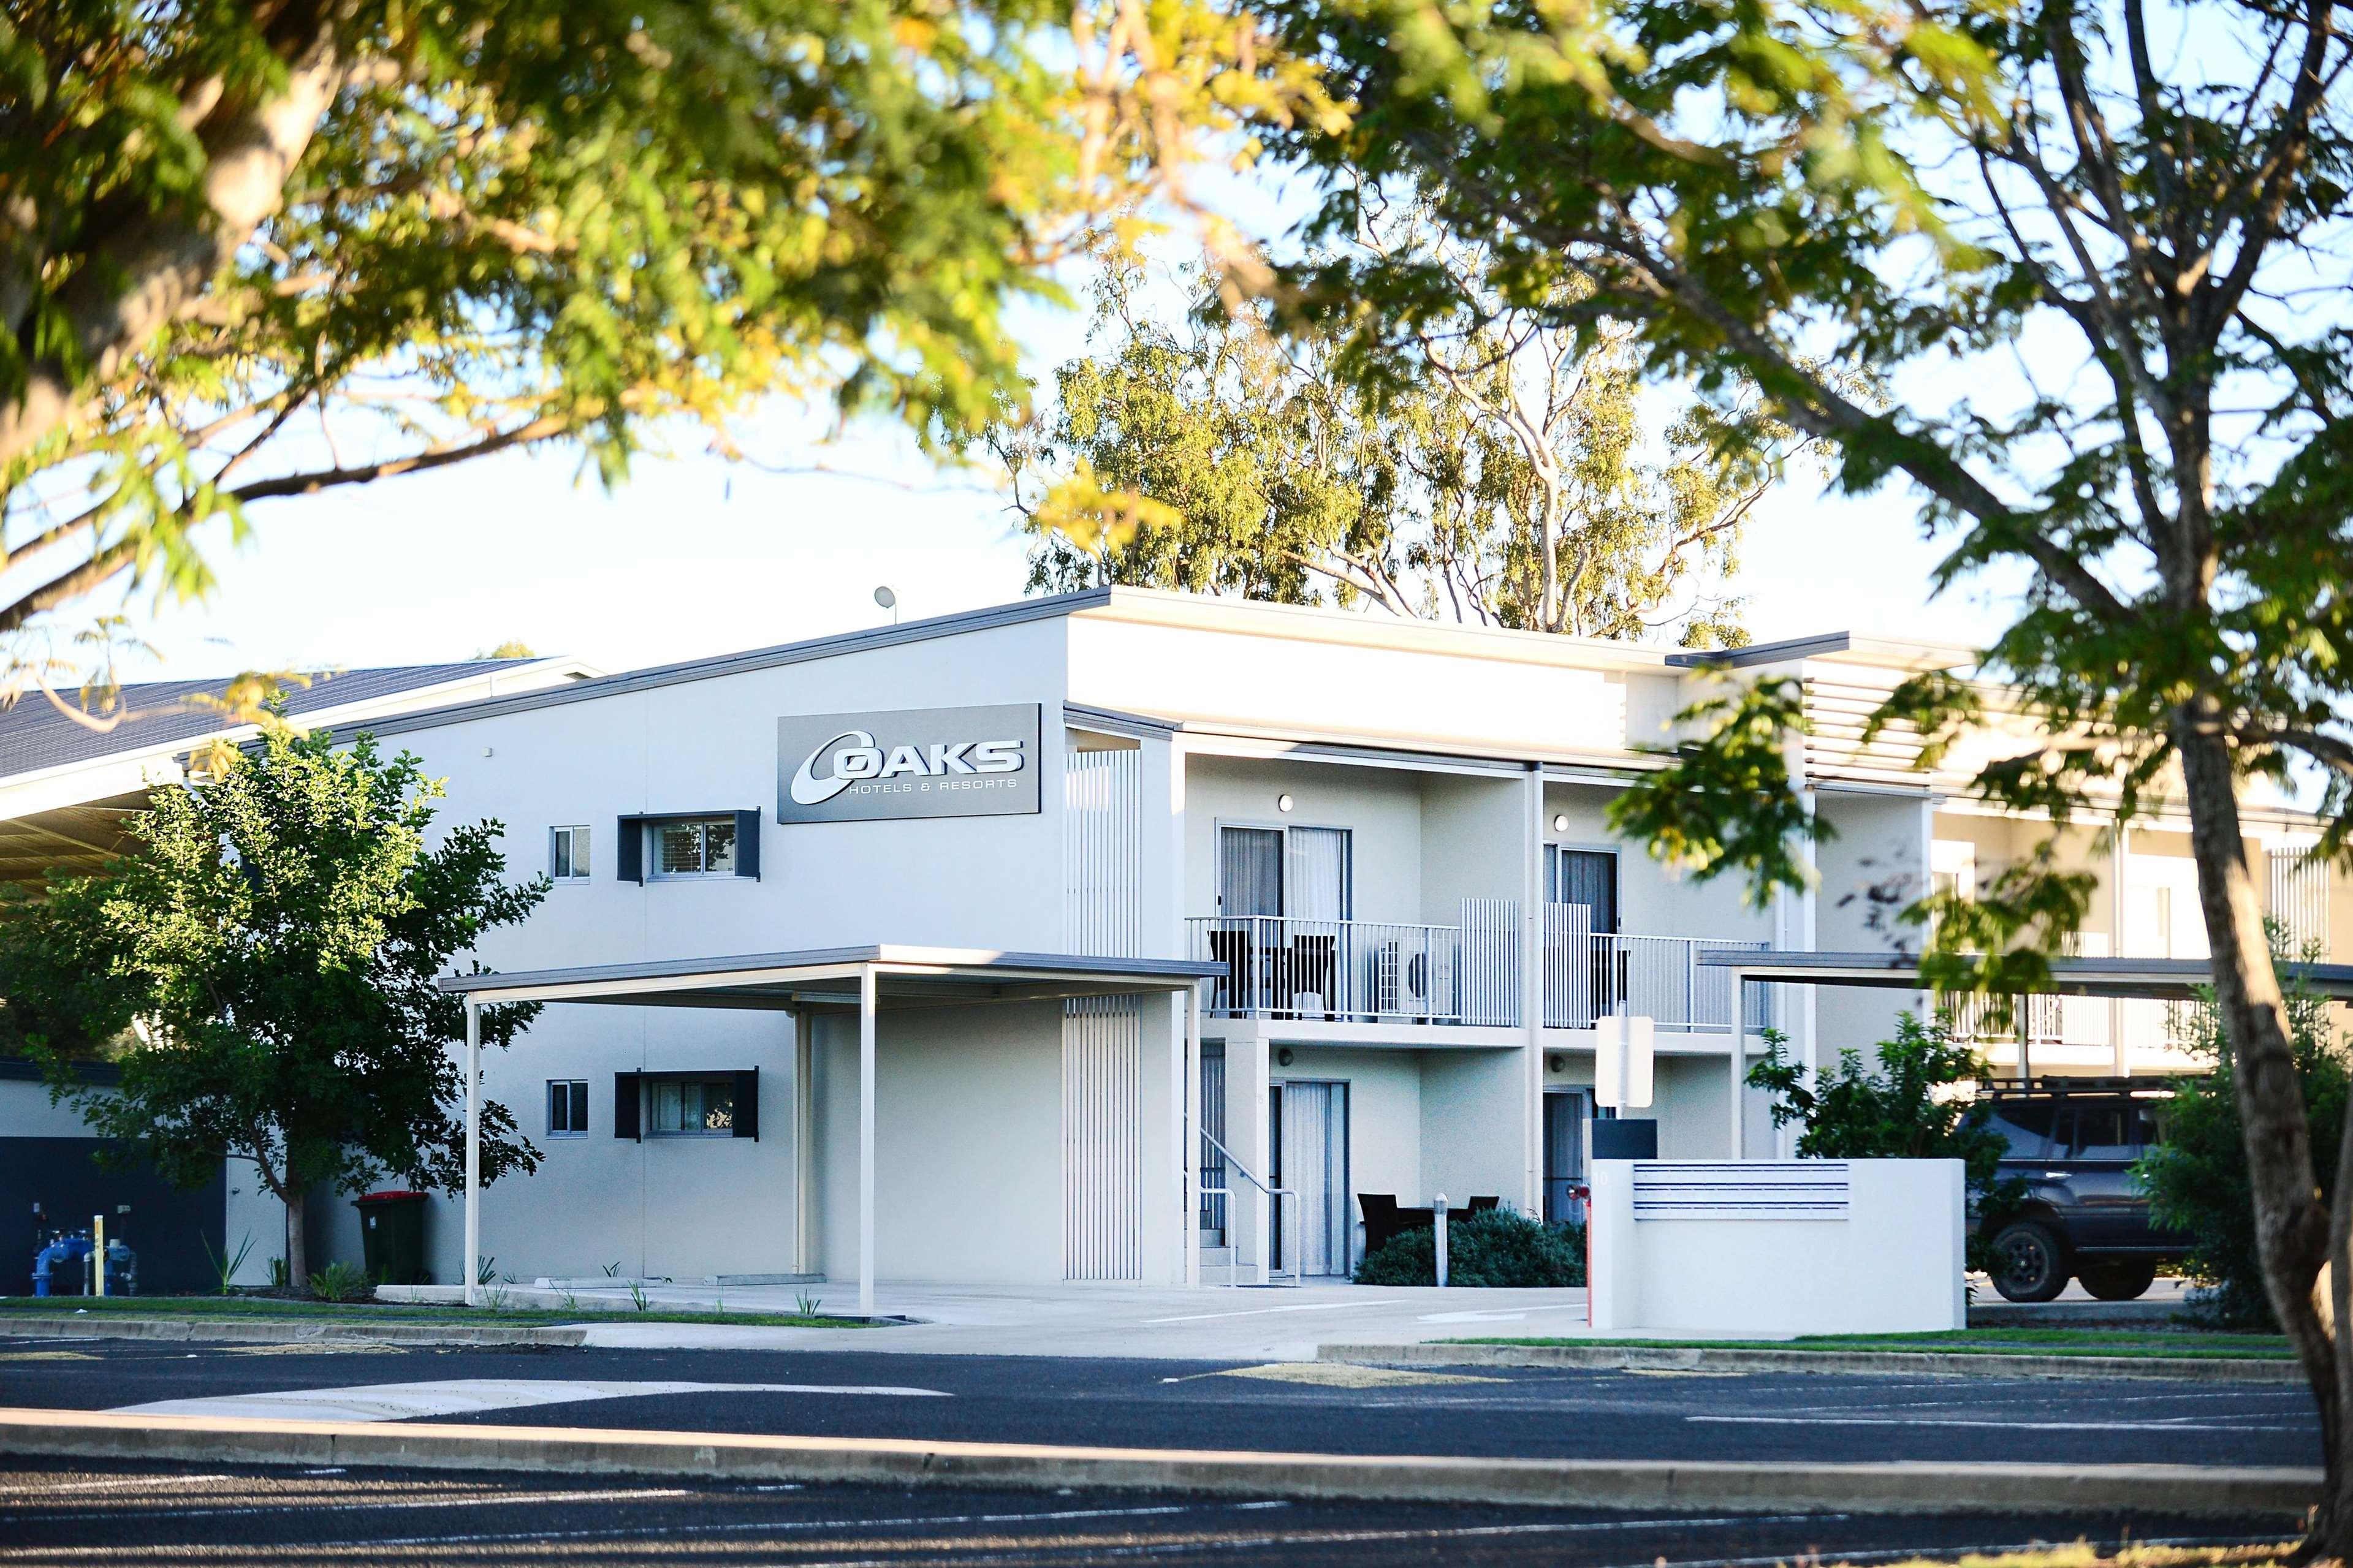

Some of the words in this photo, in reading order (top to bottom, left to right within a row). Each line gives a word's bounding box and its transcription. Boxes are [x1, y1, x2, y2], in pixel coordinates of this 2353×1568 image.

[833, 740, 1024, 780] OAKS
[849, 784, 912, 795] HOTELS
[921, 782, 930, 792] &
[940, 779, 1017, 790] RESORTS
